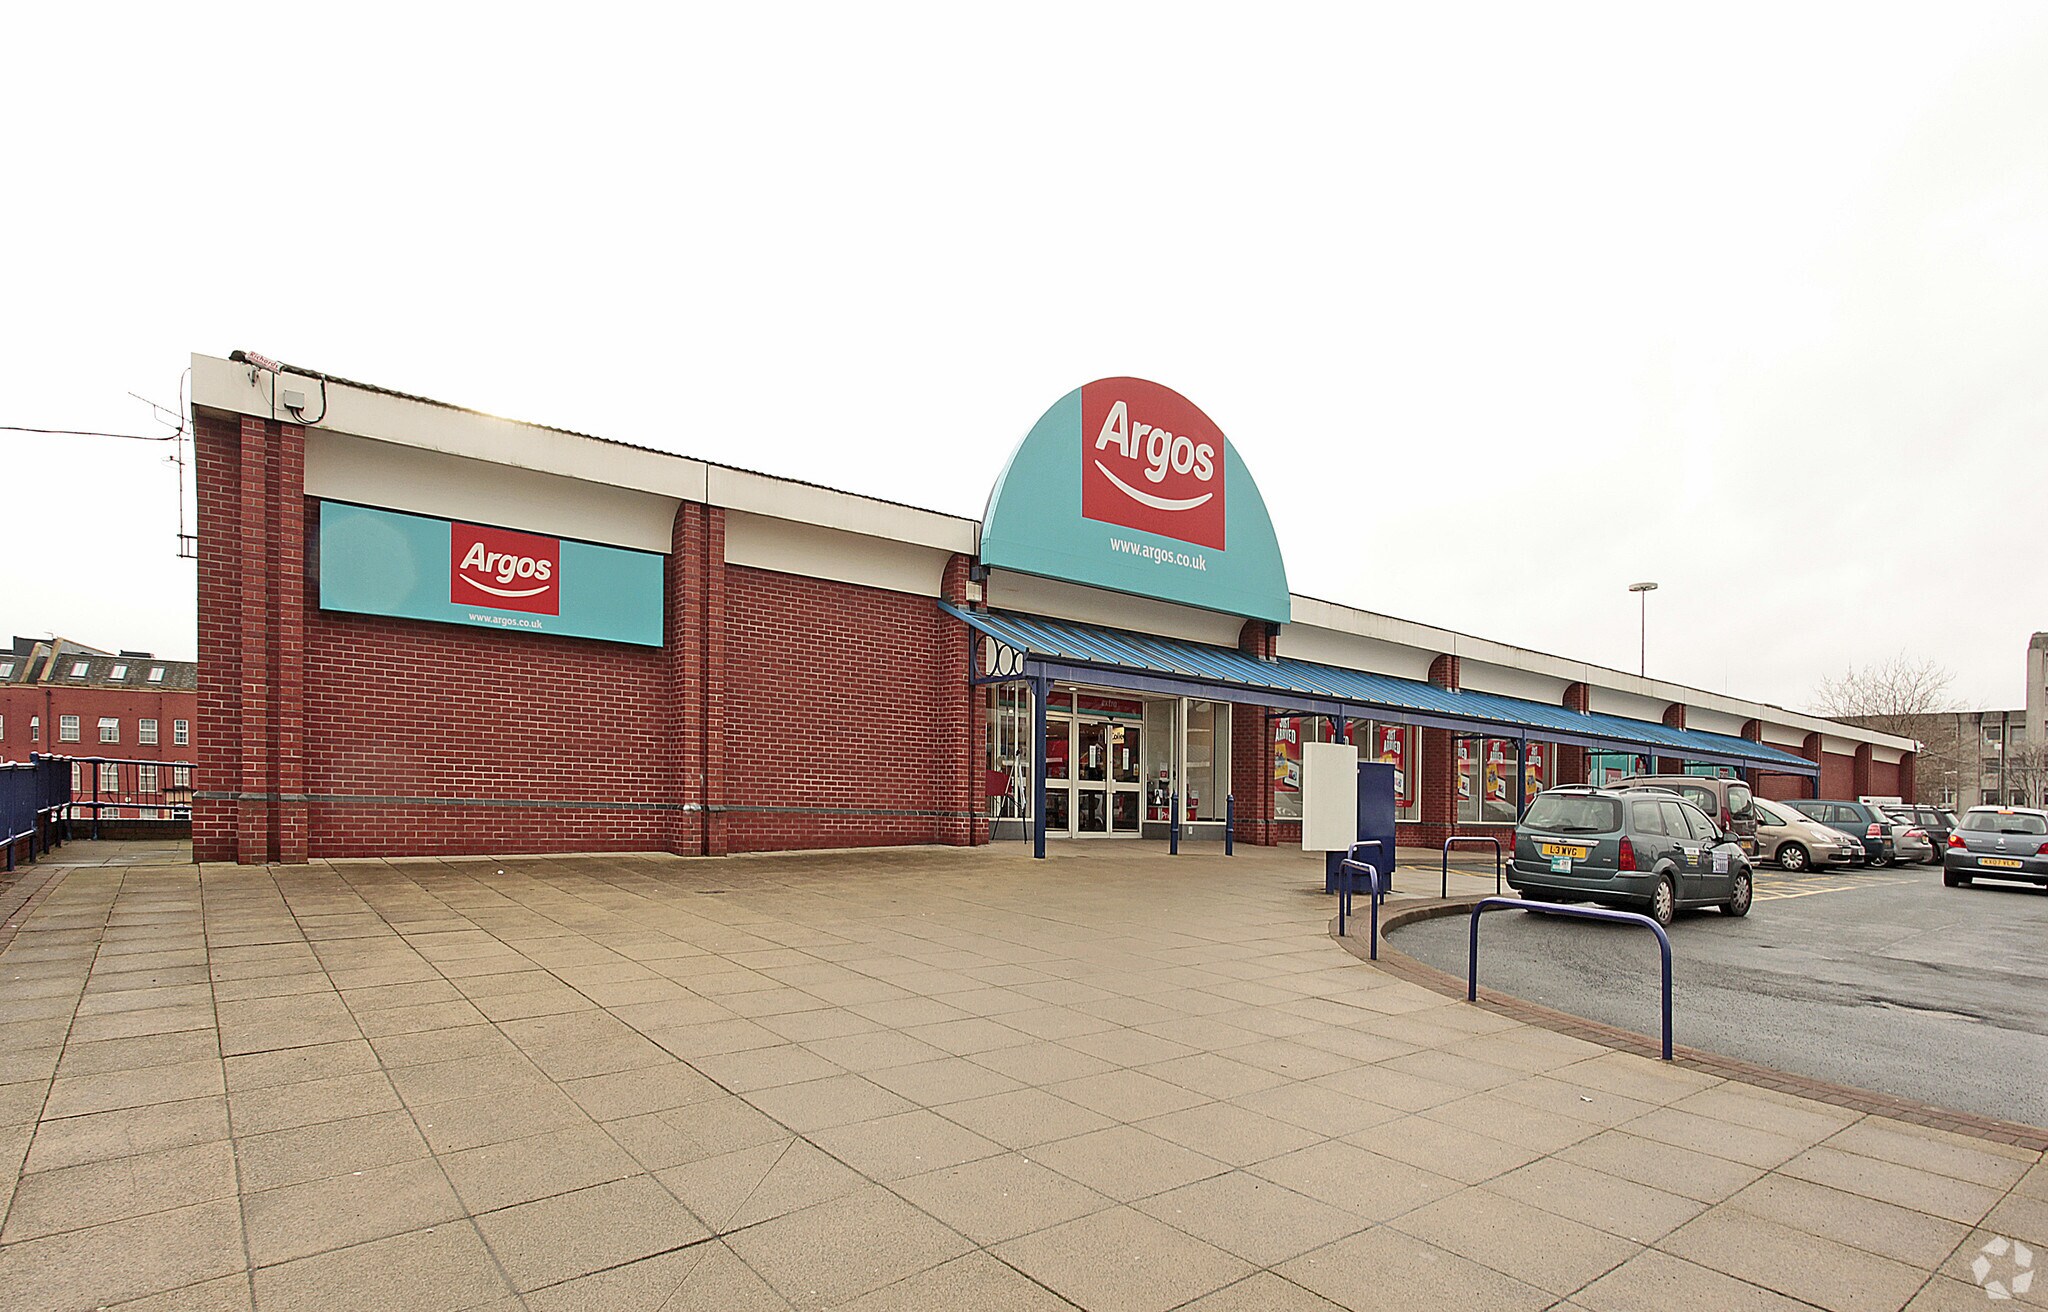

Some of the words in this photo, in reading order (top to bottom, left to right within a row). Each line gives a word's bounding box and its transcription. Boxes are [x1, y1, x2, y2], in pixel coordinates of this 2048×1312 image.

[249, 351, 279, 369] Richards
[1095, 400, 1214, 483] Argos
[459, 542, 552, 584] Argos
[1110, 538, 1206, 571] www.argos.co.uk
[468, 613, 542, 628] www.argos.co.uk
[1550, 845, 1560, 854] L3
